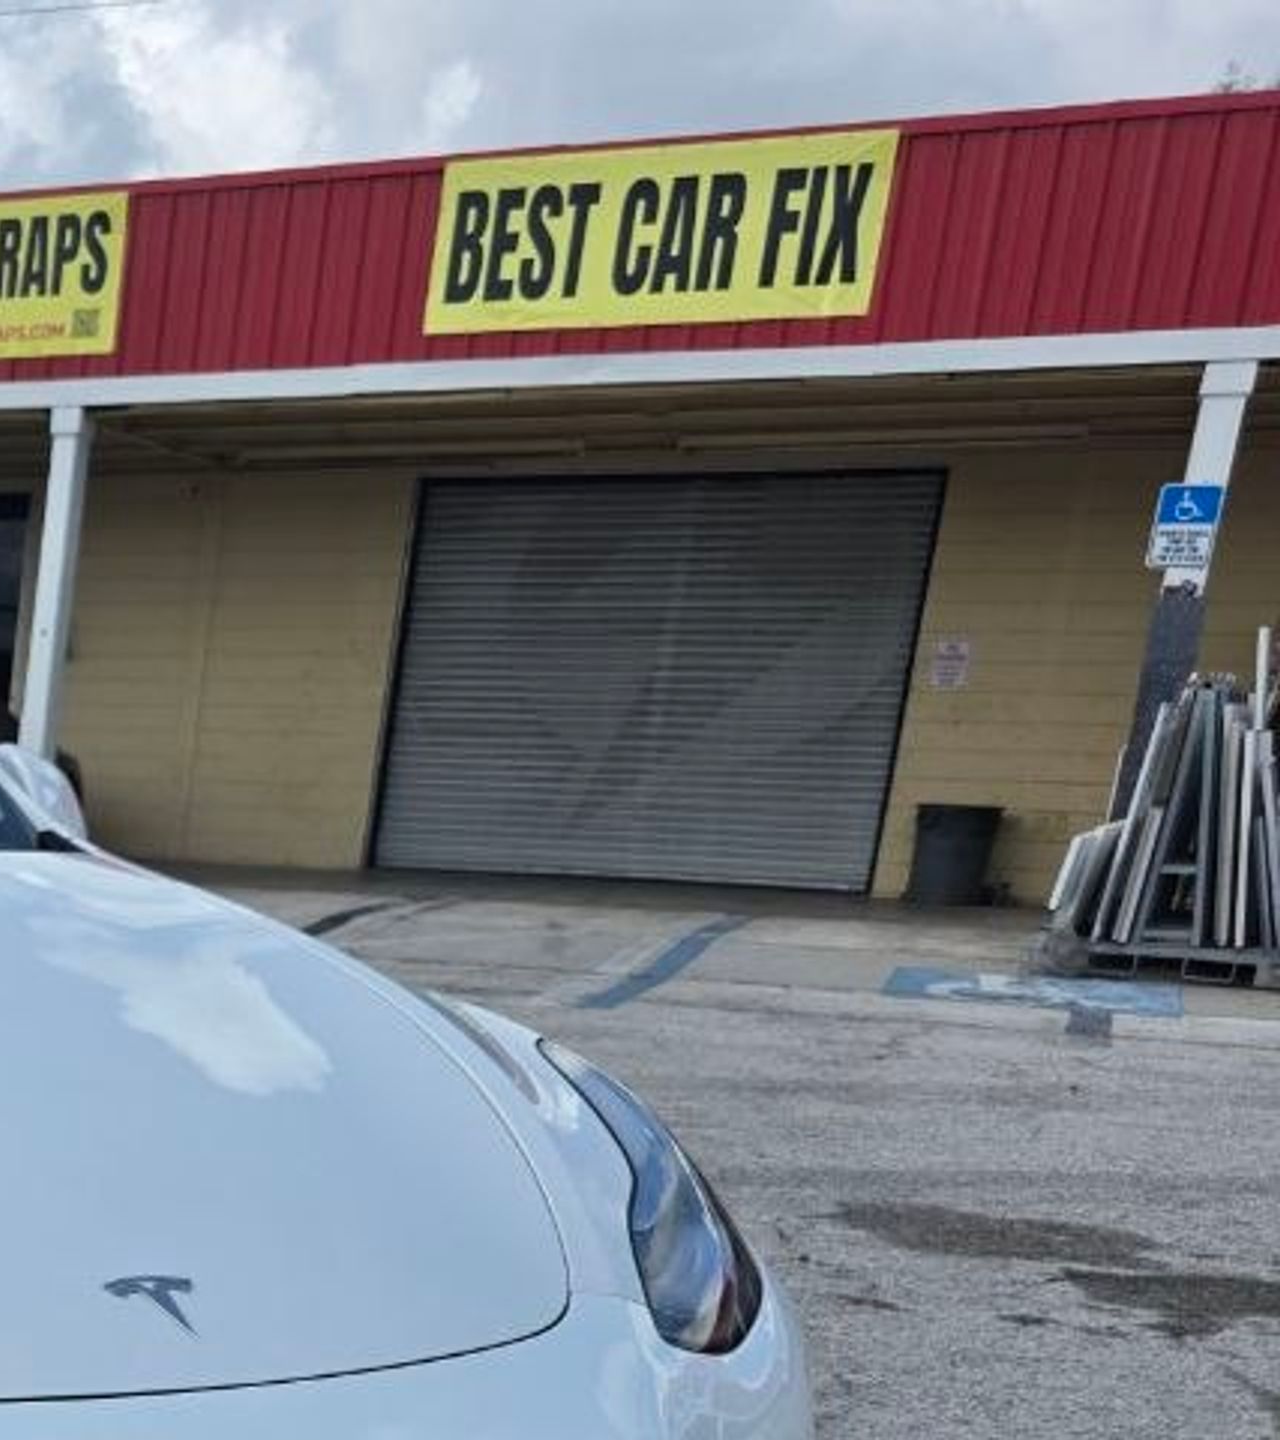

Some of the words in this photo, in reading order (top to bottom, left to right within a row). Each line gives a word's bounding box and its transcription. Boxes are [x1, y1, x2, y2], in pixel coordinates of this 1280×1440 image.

[442, 182, 603, 304] BEST
[611, 173, 748, 296] CAR
[757, 162, 875, 288] FIX
